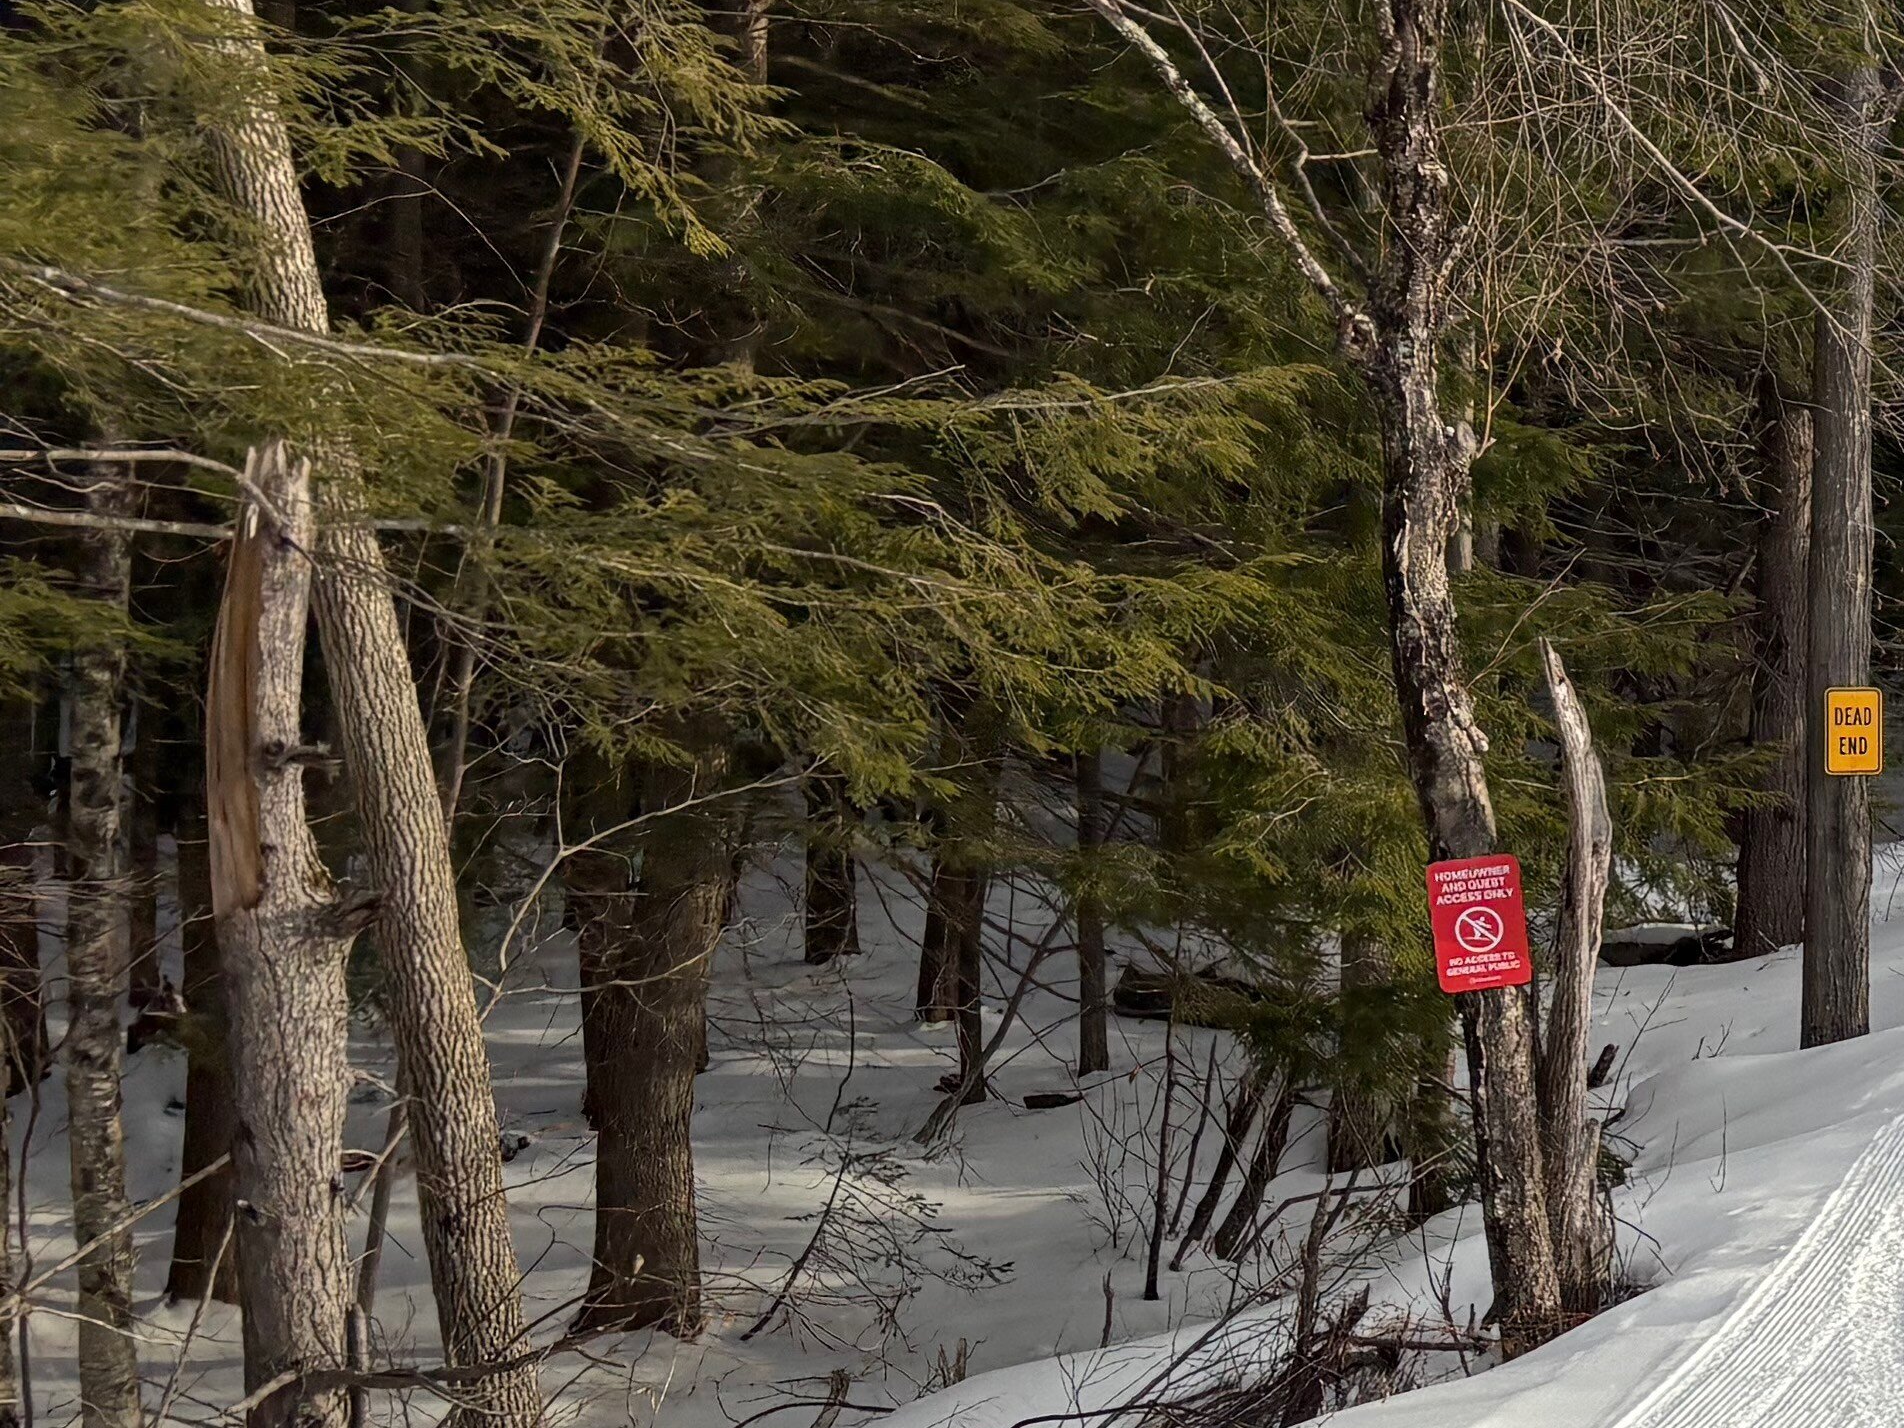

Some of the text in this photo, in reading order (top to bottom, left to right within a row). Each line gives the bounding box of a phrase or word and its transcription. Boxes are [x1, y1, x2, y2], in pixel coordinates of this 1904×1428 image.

[1834, 707, 1872, 726] DEAD
[1839, 736, 1868, 755] END
[1441, 881, 1467, 893] AND
[1436, 888, 1514, 906] ACCESS ONLY
[1449, 957, 1463, 966] NO
